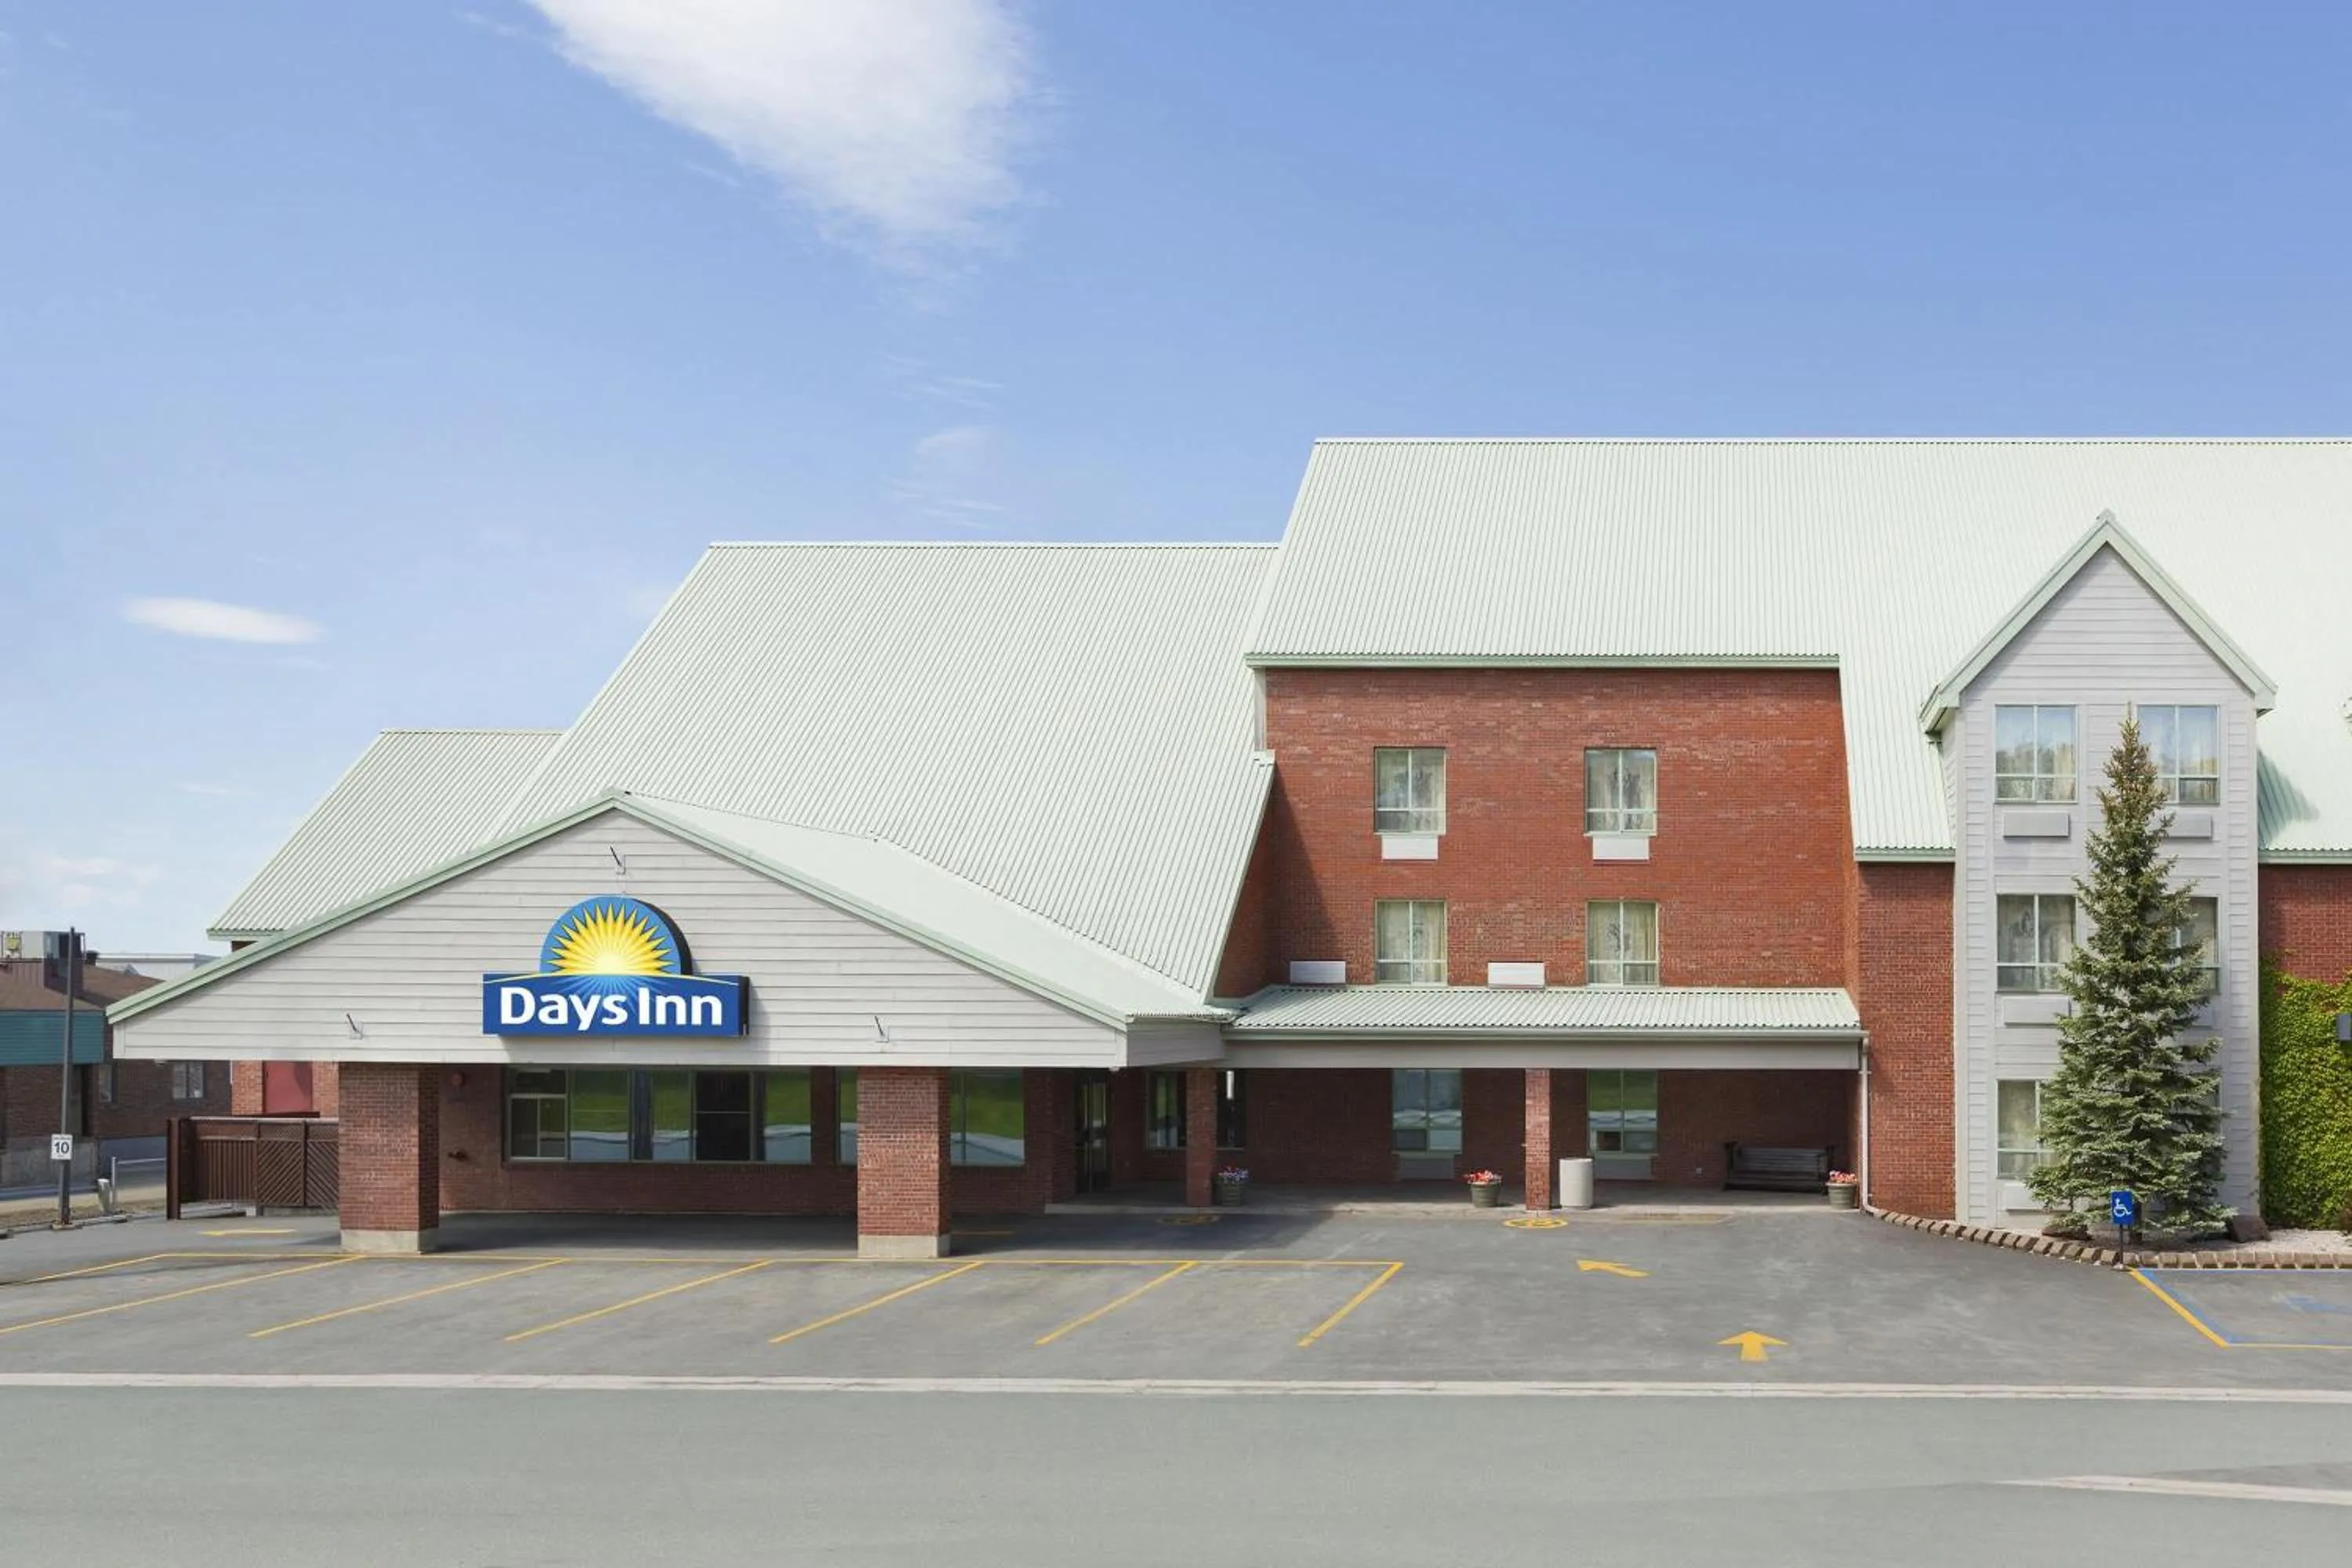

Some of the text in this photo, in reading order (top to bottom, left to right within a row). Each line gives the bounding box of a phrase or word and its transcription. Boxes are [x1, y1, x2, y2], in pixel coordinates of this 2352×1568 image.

[500, 987, 723, 1031] Days Inn
[55, 1142, 69, 1154] 10
